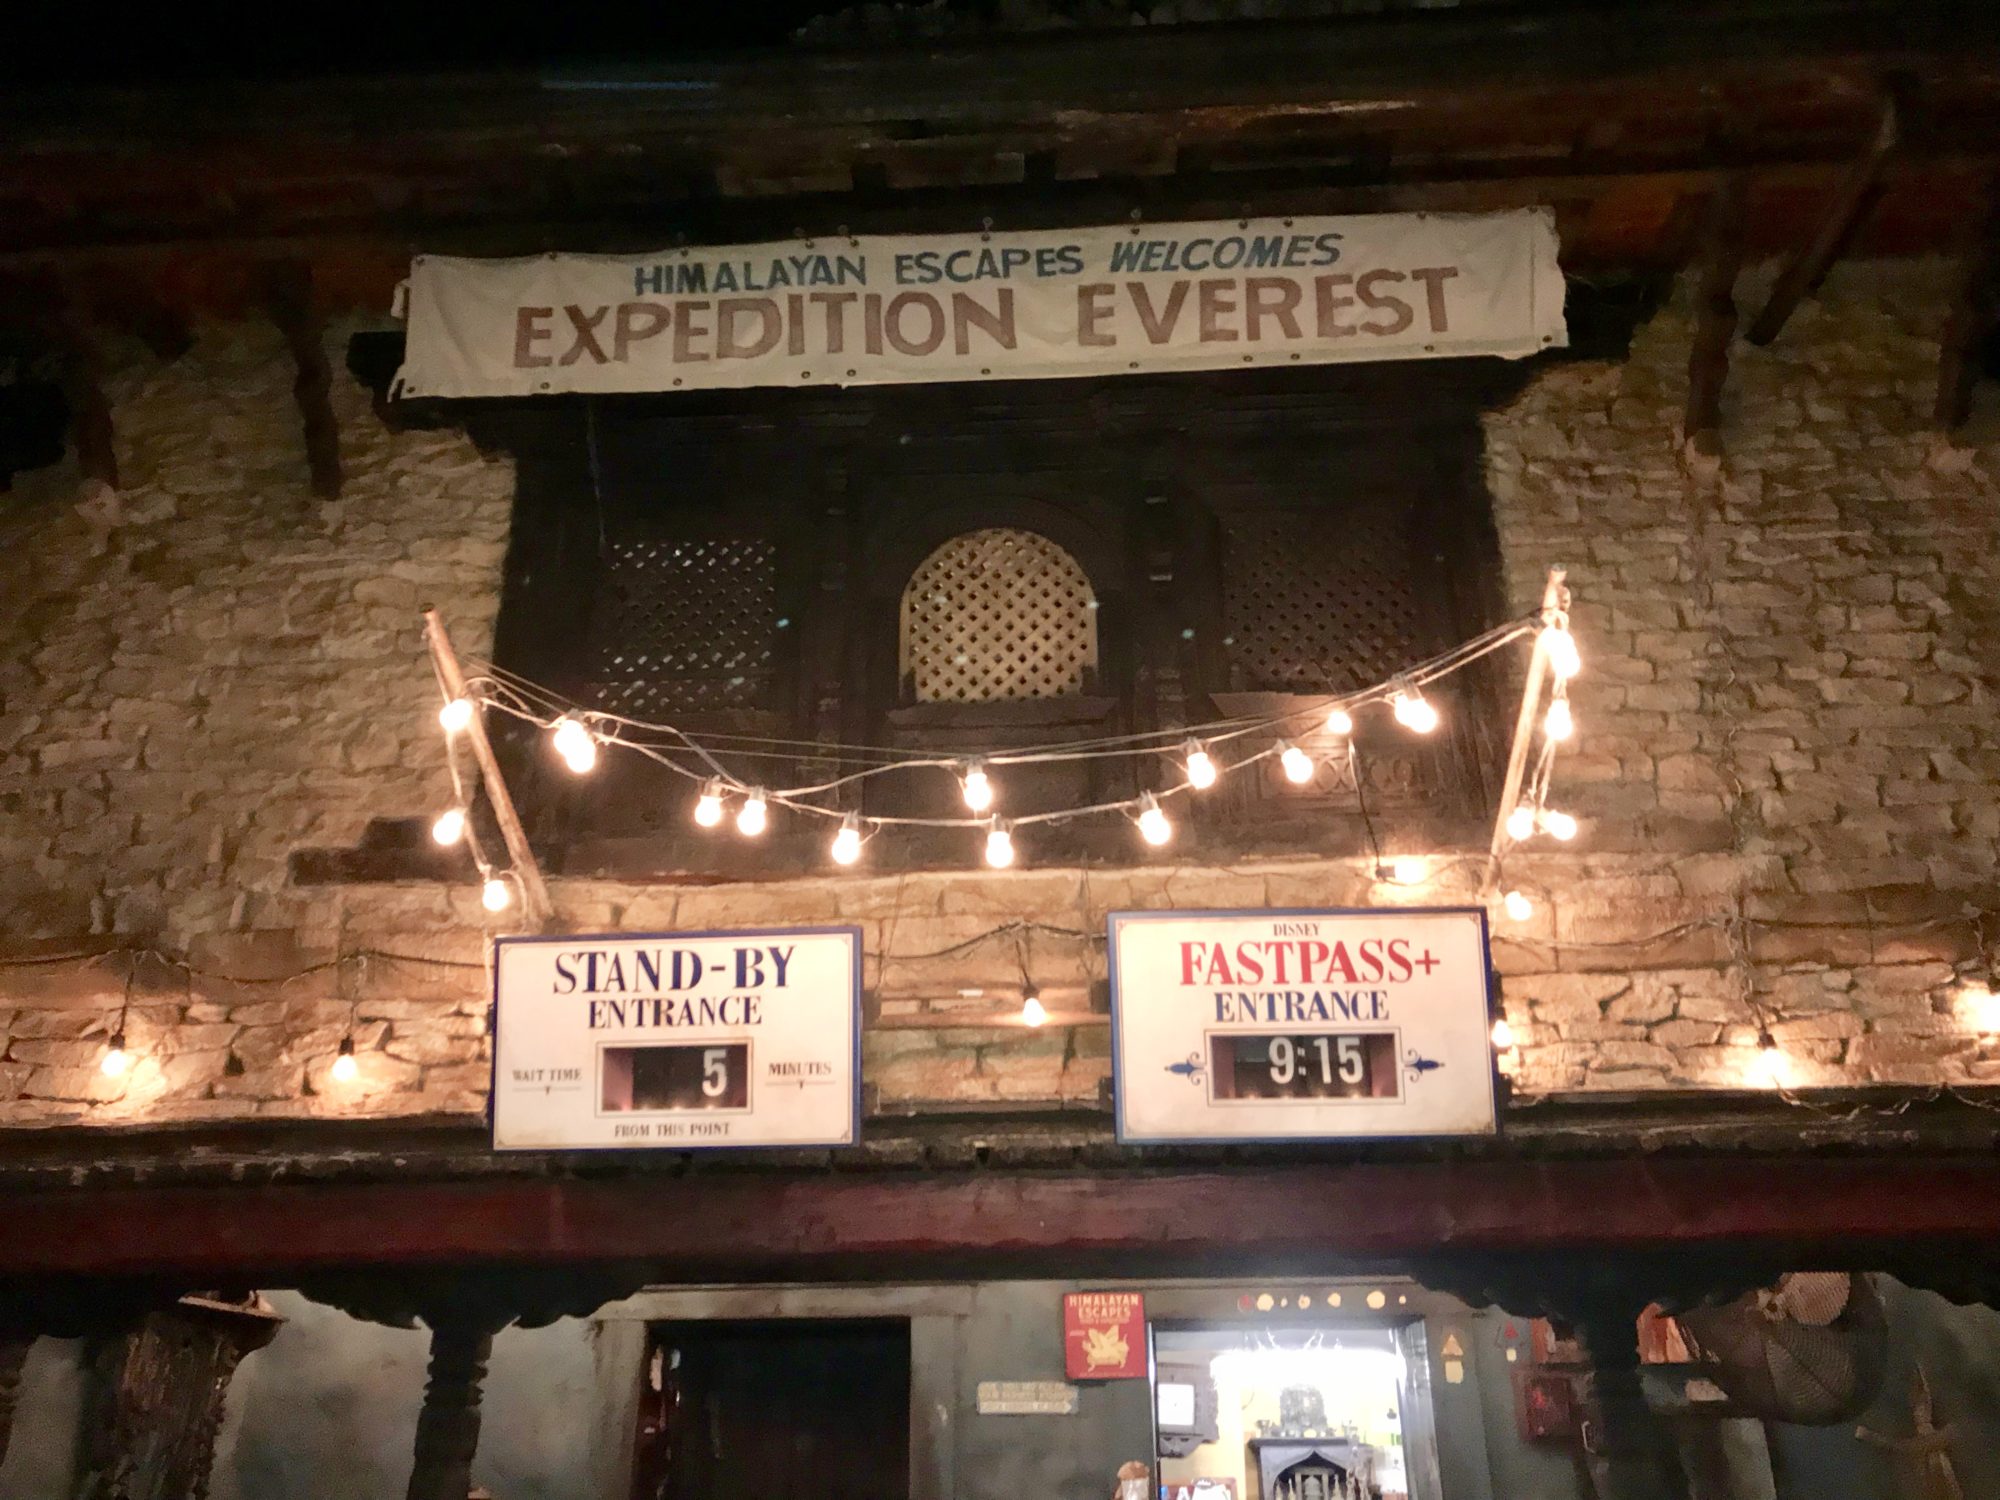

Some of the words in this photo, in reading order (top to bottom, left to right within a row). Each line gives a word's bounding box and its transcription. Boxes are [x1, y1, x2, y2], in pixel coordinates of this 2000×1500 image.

[634, 253, 867, 297] HIMALAYAN
[895, 246, 1084, 285] ESCAPES
[1110, 233, 1344, 273] WELCOMES
[513, 287, 1017, 369] EXPEDITION
[1077, 265, 1459, 347] EVEREST
[1273, 923, 1320, 937] DISNEY
[553, 945, 798, 995] STAND-BY
[1179, 939, 1440, 986] FASTPASS+
[588, 996, 763, 1030] ENTRANCE
[1214, 990, 1390, 1023] ENTRANCE
[512, 1069, 544, 1082] WAIT
[550, 1067, 582, 1082] TIME
[702, 1049, 728, 1097] 5
[768, 1061, 832, 1077] MINUTES
[1268, 1036, 1364, 1085] 9:15
[614, 1123, 650, 1138] FROM
[656, 1122, 685, 1137] THIS
[690, 1120, 730, 1136] POINT
[1069, 1293, 1139, 1307] HIMALAYAN
[1078, 1306, 1132, 1318] ESCAPES
